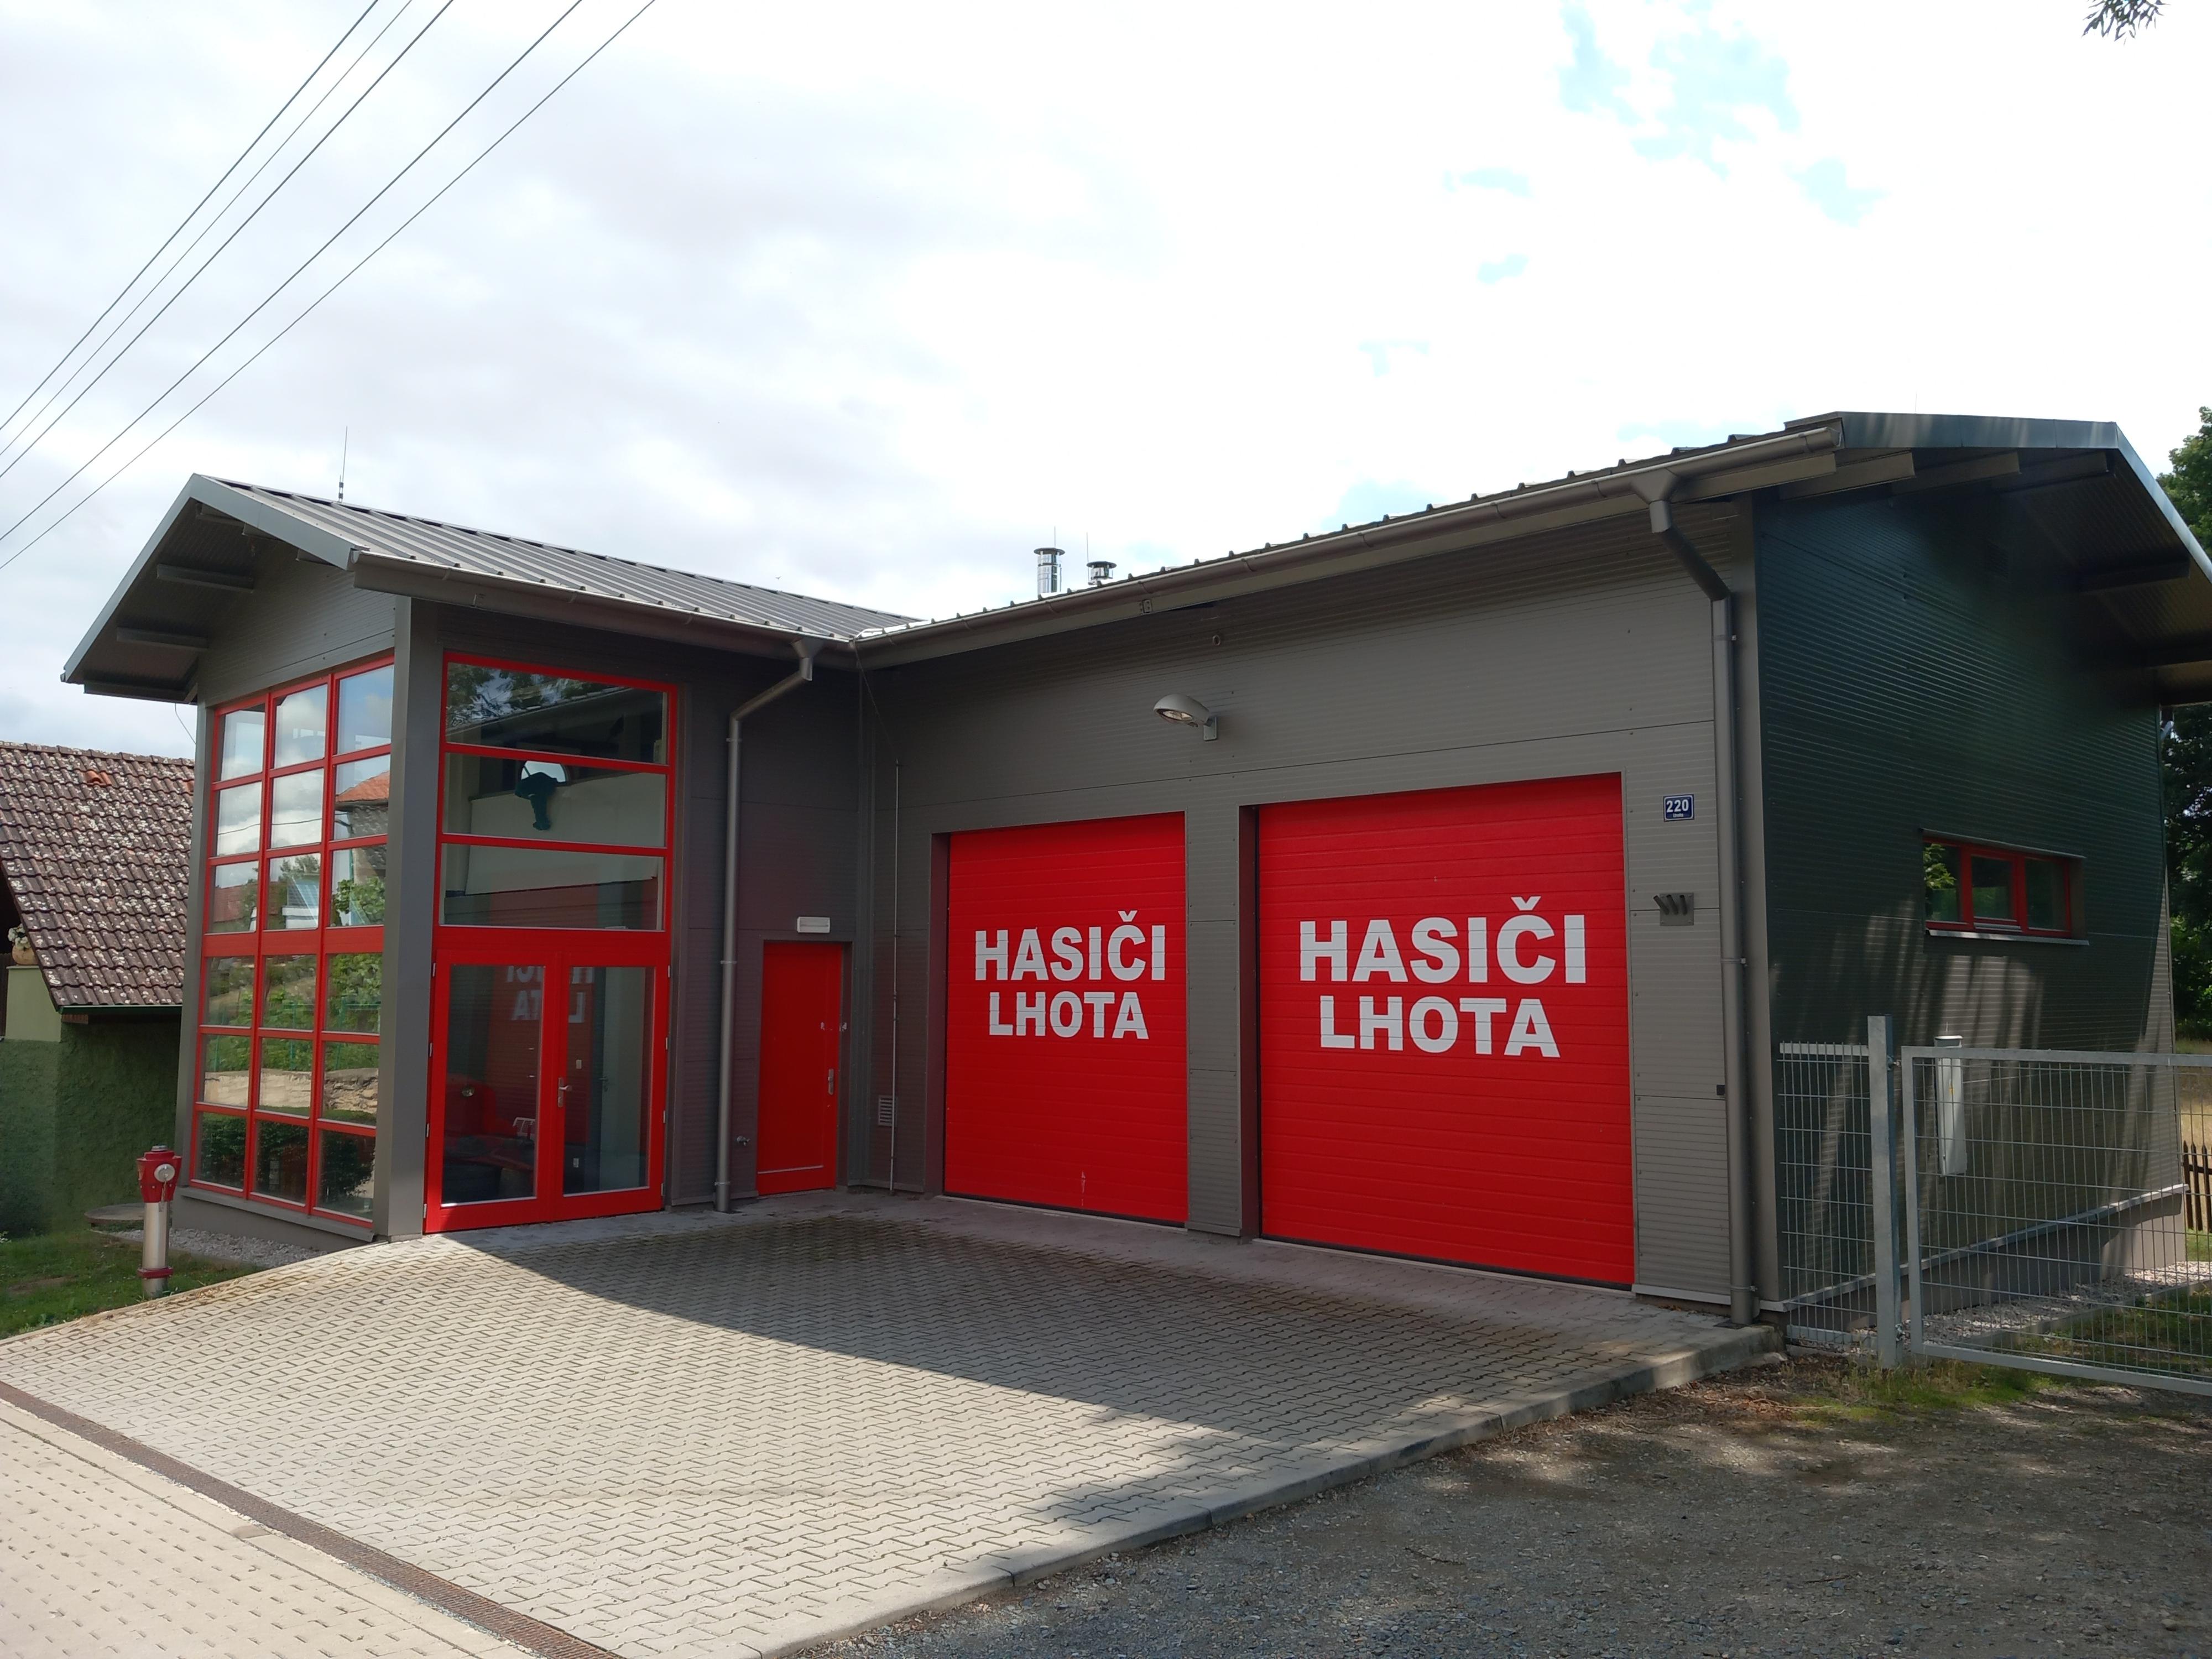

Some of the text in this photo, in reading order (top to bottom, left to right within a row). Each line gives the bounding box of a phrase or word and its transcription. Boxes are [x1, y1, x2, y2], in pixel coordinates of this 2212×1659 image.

[1666, 799, 1689, 812] 220
[975, 910, 1166, 981] HASIČI
[1300, 896, 1586, 984] HASIČI
[989, 991, 1149, 1040] LHOTA
[1320, 995, 1561, 1058] LHOTA
